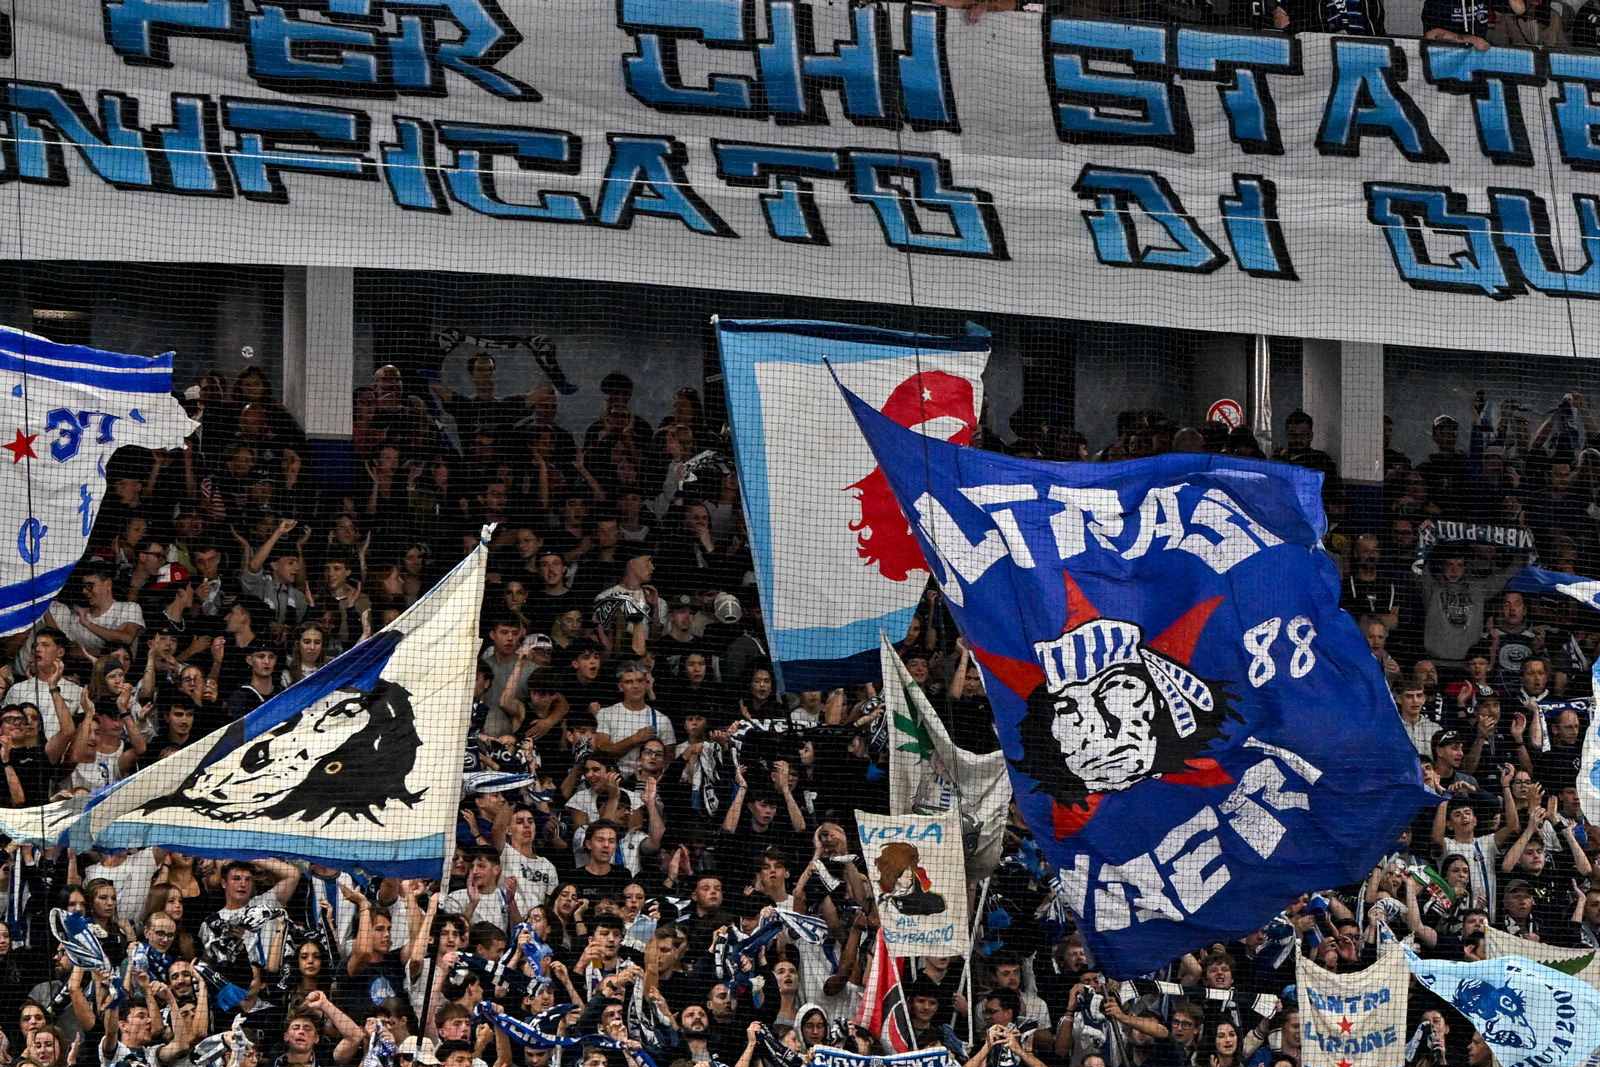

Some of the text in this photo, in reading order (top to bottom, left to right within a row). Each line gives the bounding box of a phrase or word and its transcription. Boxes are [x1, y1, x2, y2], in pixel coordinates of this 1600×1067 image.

[615, 0, 960, 133] CHI
[1072, 164, 1300, 281] DI
[1243, 616, 1317, 688] 88
[858, 822, 943, 845] VOLA
